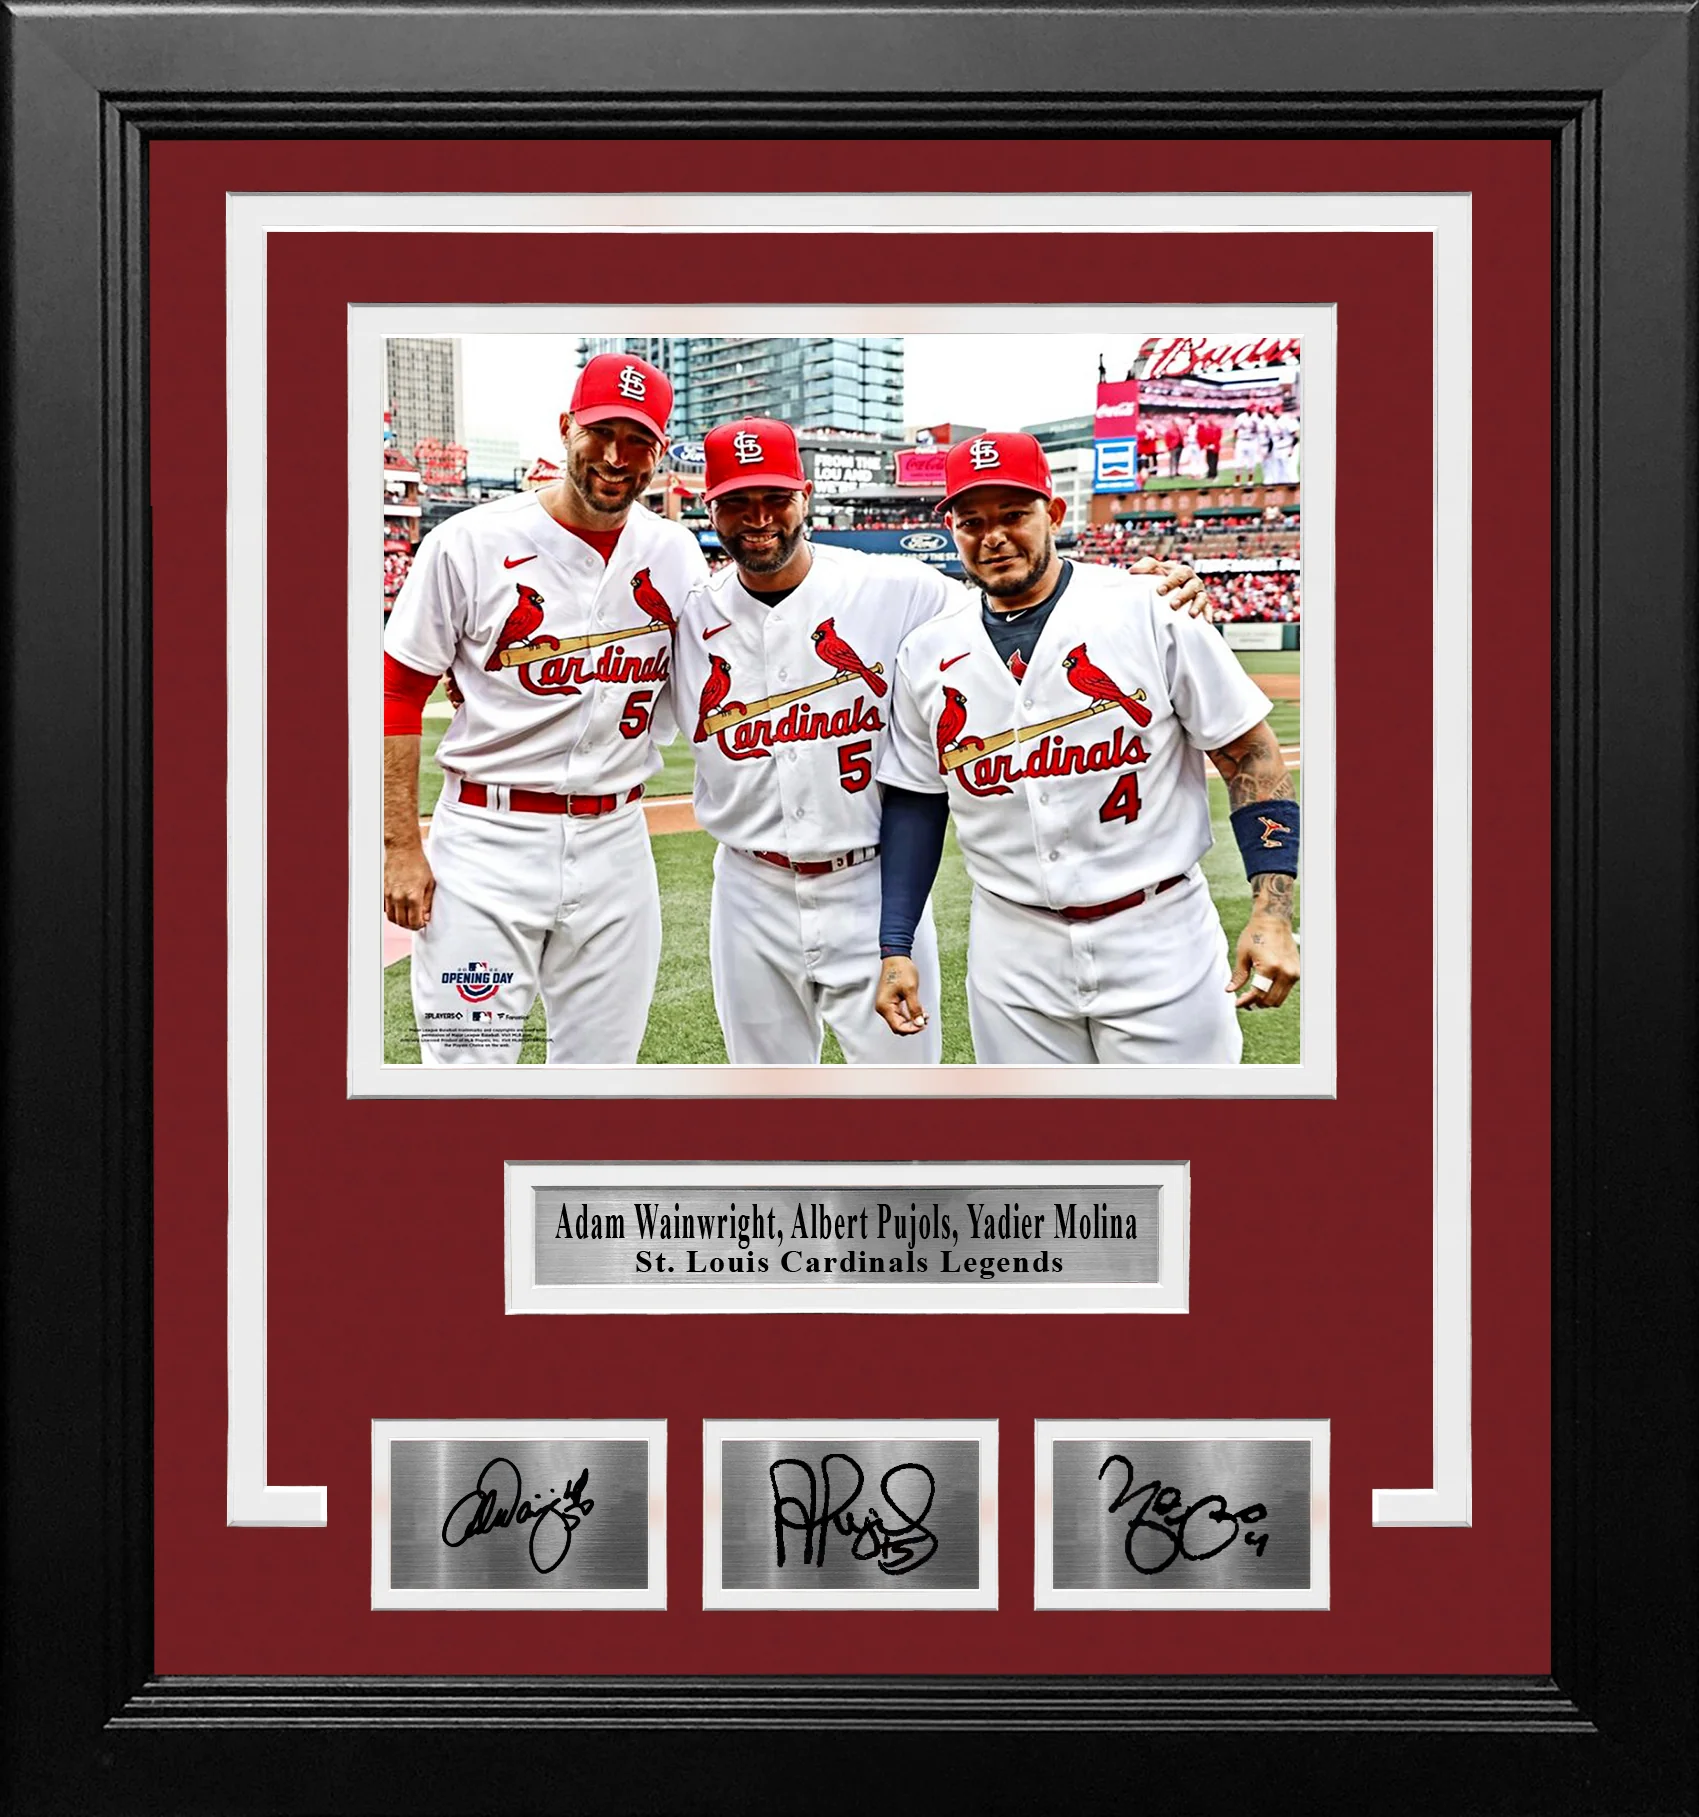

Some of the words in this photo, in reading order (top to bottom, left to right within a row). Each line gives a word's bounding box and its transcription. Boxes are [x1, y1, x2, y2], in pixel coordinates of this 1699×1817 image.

[814, 454, 854, 468] FROM
[855, 456, 881, 470] THE
[814, 467, 842, 480] LOU
[843, 468, 873, 482] AND
[518, 635, 670, 696] Cardinals
[717, 695, 886, 761] Cardinals
[837, 739, 872, 794] 5
[955, 726, 1152, 797] Cardinals
[1099, 771, 1142, 825] 4
[555, 1202, 625, 1239] Adam
[634, 1202, 783, 1249] Wainwright,
[791, 1202, 868, 1239] Albert
[877, 1202, 958, 1249] Pujols,
[966, 1202, 1045, 1239] Yadier
[1053, 1202, 1138, 1239] Molina
[636, 1250, 675, 1273] St.
[686, 1250, 769, 1273] Louis
[781, 1250, 928, 1273] Cardinals
[940, 1250, 1063, 1280] Legends
